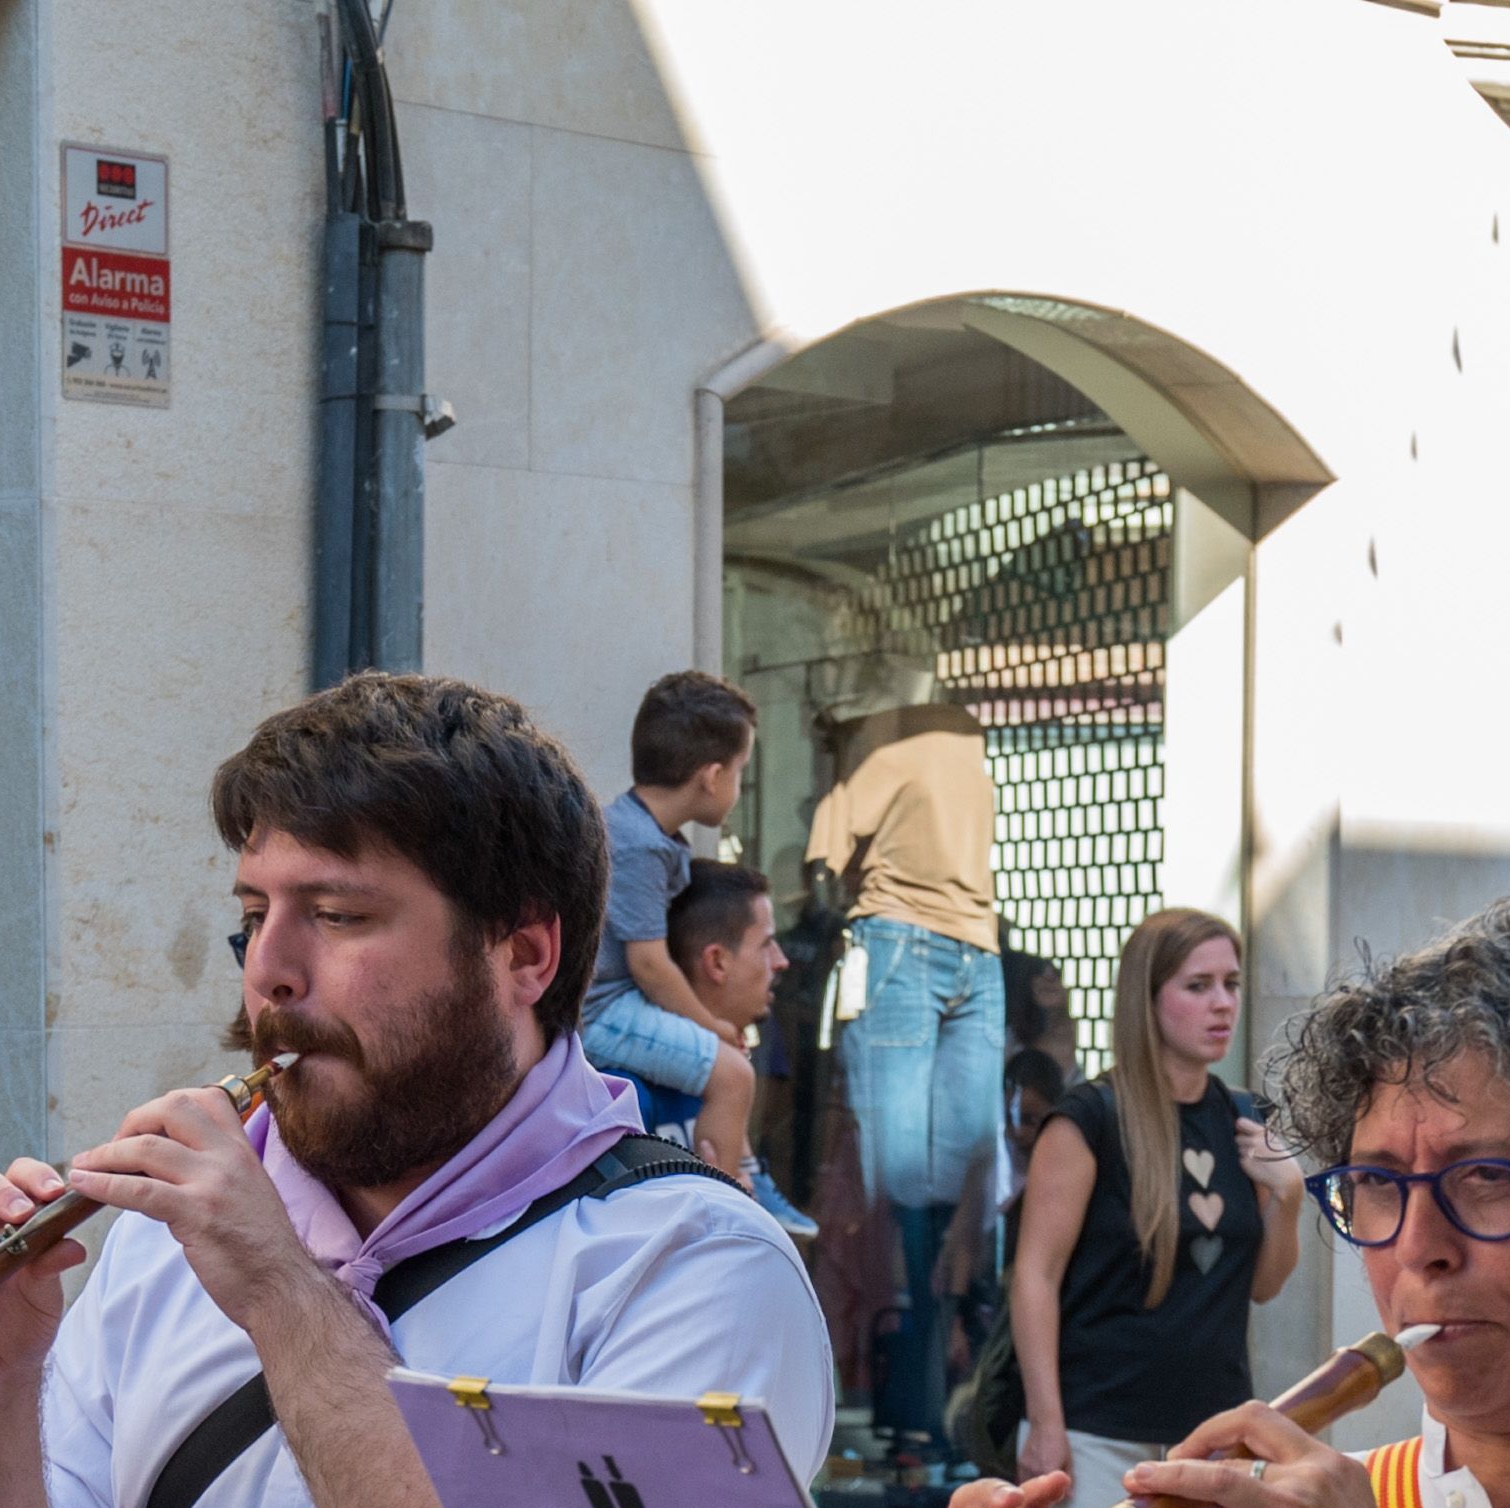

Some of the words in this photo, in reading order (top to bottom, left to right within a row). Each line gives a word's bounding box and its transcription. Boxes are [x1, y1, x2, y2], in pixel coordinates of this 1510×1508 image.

[79, 198, 154, 237] Direct
[69, 256, 165, 297] Alarma
[68, 292, 89, 305] con
[91, 292, 121, 310] Aviso
[122, 300, 129, 311] a
